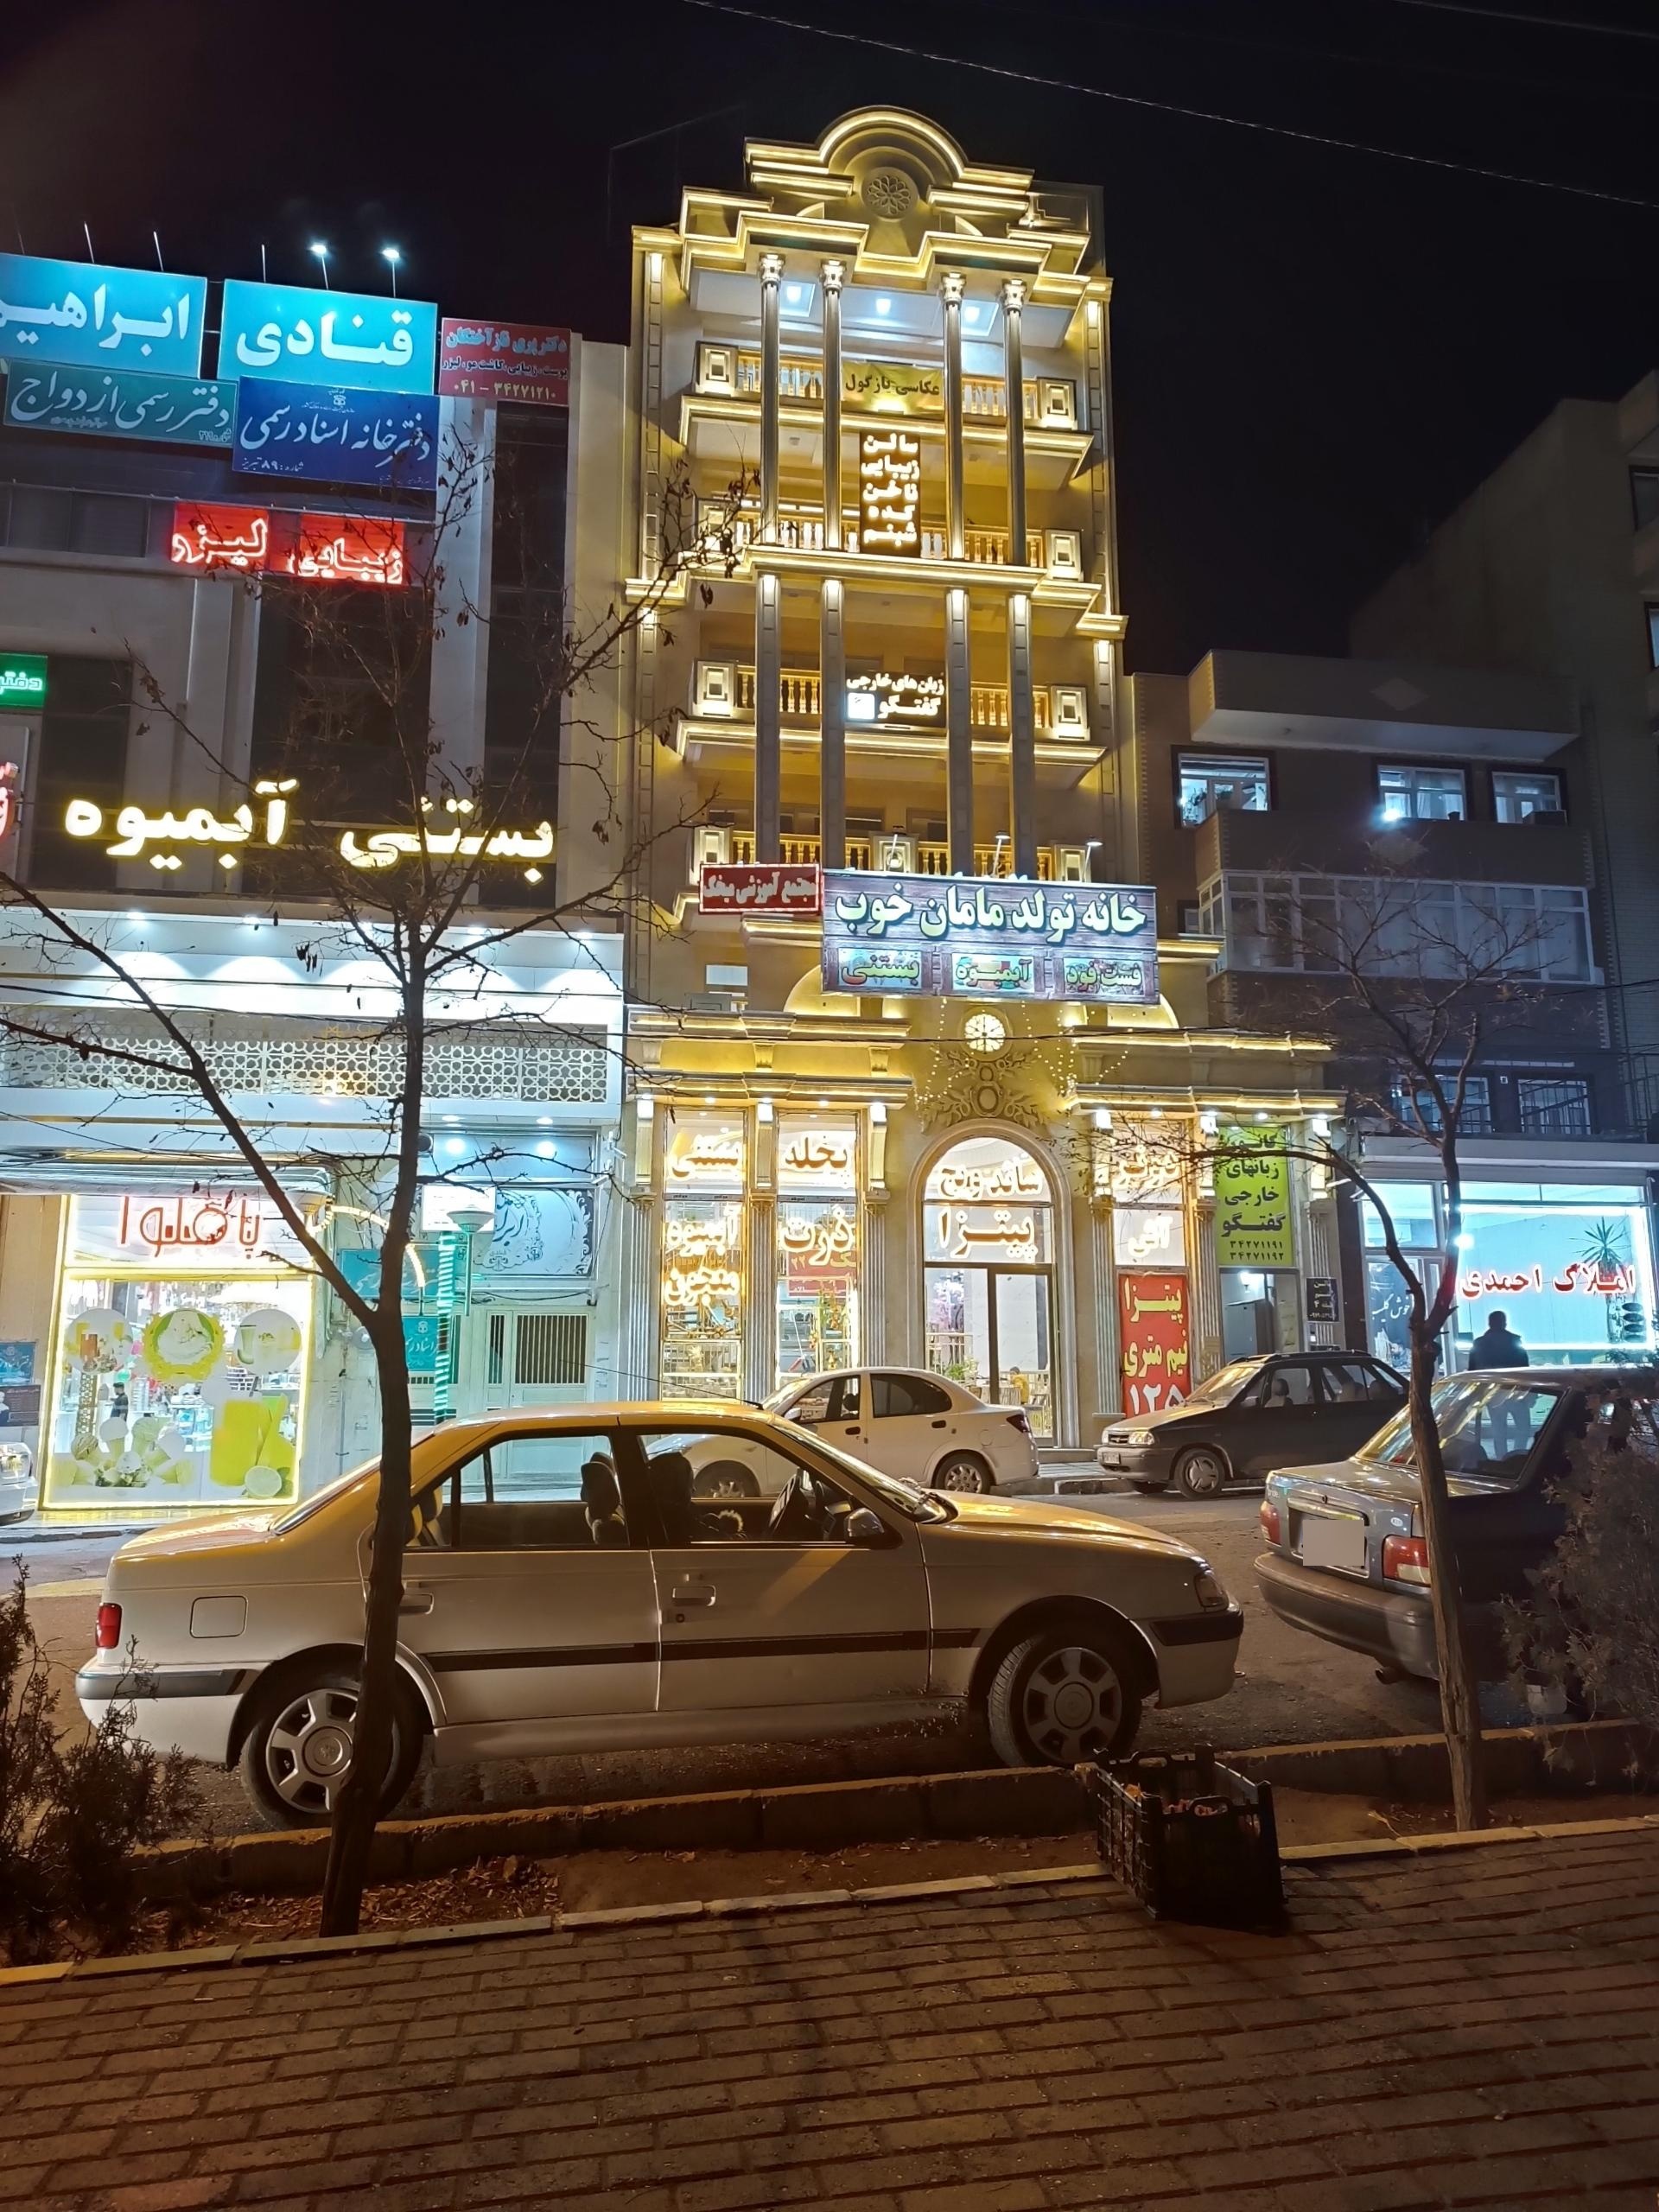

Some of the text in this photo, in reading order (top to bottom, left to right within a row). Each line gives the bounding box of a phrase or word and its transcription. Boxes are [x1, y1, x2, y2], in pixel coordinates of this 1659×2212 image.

[236, 309, 414, 366] قنادی
[10, 370, 230, 432] دفتر رسمی ازدواج
[895, 379, 941, 397] عکاسی
[239, 404, 291, 450] رسمی
[293, 413, 349, 445] اسناد
[261, 460, 278, 470] ۸۹
[861, 454, 920, 480] زیبایی
[862, 480, 919, 501] ناخن
[863, 520, 918, 547] شبنم
[846, 672, 893, 691] خارجی
[877, 693, 942, 719] گفتگو
[65, 778, 301, 871] آبمیوه
[340, 795, 555, 887] بستنی
[834, 881, 1147, 944] خانه تولد مامان خوب
[841, 953, 1143, 988] بستنی آبمیوه فست فود
[669, 1137, 741, 1180] بستنی
[1226, 1156, 1280, 1179] زبانهای
[1224, 1185, 1280, 1206] خارجی
[780, 1205, 854, 1267] ذرت
[938, 1207, 1039, 1262] پیتزا
[1221, 1212, 1287, 1237] گفتگو
[1230, 1240, 1284, 1249] ۳۴۲۷۱۱۹۱
[1459, 1263, 1637, 1300] املاک احمدی
[1125, 1277, 1184, 1325] پیتزا
[1124, 1328, 1188, 1378] نیم متری
[1129, 1383, 1186, 1415] ۱۲۵
